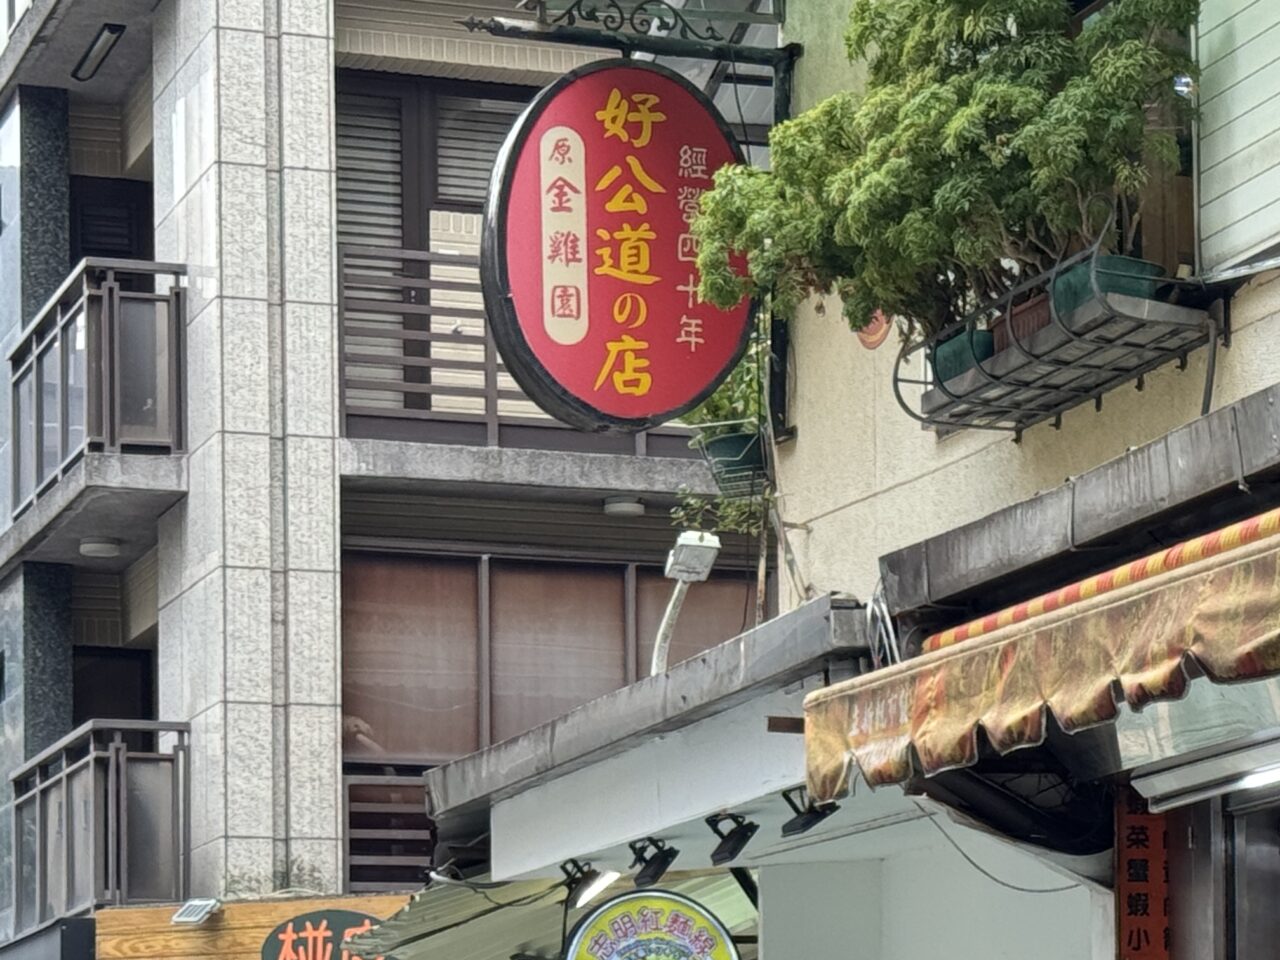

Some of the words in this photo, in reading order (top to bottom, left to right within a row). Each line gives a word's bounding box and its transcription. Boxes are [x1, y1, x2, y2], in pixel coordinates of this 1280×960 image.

[546, 138, 582, 320] 原金雞園
[594, 88, 667, 396] 好公道の店
